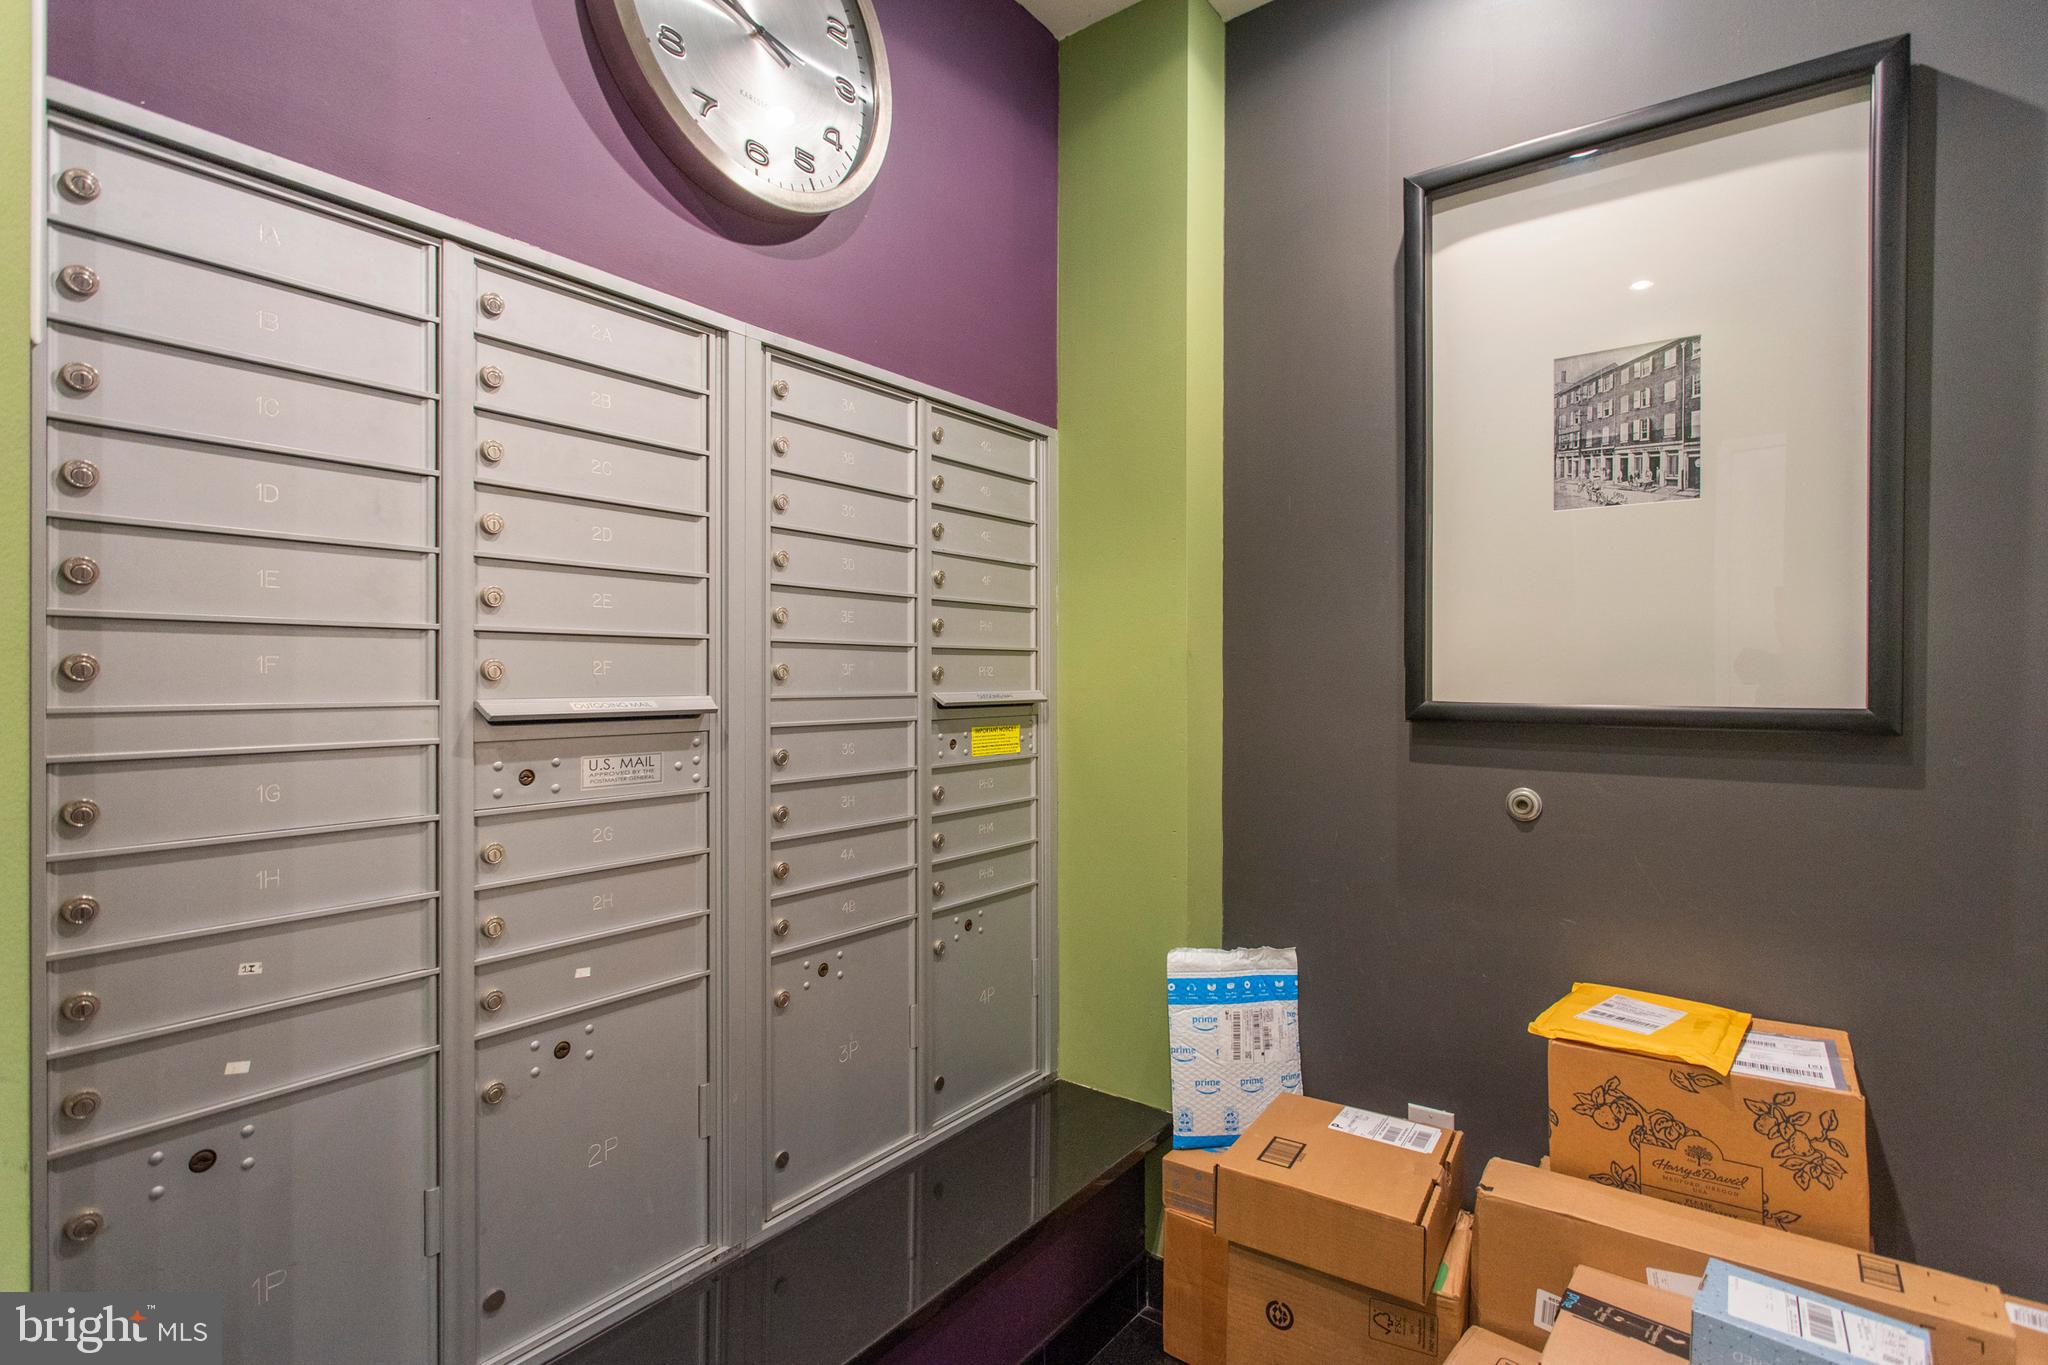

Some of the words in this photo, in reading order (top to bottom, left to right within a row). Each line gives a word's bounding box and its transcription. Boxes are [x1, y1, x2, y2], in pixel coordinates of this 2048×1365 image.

[826, 16, 849, 47] 2
[658, 25, 686, 58] 8
[835, 76, 856, 103] 3
[691, 87, 719, 118] 7
[822, 127, 843, 151] 4
[745, 139, 769, 166] 6
[793, 146, 815, 174] 5
[258, 224, 281, 248] 1A
[255, 310, 280, 332] 1B
[591, 324, 612, 344] 2A
[255, 396, 280, 417] 1C
[591, 391, 611, 409] 2B
[591, 459, 612, 477] 2C
[255, 483, 279, 503] 1D
[591, 526, 612, 542] 2D
[256, 570, 281, 589] 1E
[592, 593, 613, 609] 2E
[255, 655, 280, 674] 1F
[592, 661, 612, 676] 2F
[841, 663, 855, 675] 3F
[588, 758, 615, 771] U.S.
[620, 755, 655, 769] MAIL
[256, 783, 280, 803] 1G
[592, 827, 614, 844] 2G
[840, 847, 855, 861] 4A
[255, 867, 280, 890] 1H
[592, 893, 614, 911] 2H
[841, 899, 856, 914] 4B
[979, 986, 996, 1005] 4P
[1192, 1015, 1218, 1024] prime
[839, 1040, 859, 1064] 3P
[1171, 1045, 1196, 1055] prime
[1195, 1079, 1221, 1088] prime
[1240, 1076, 1264, 1087] prime
[1281, 1072, 1300, 1082] prime
[588, 1136, 618, 1168] 2P
[252, 1268, 288, 1305] 1P
